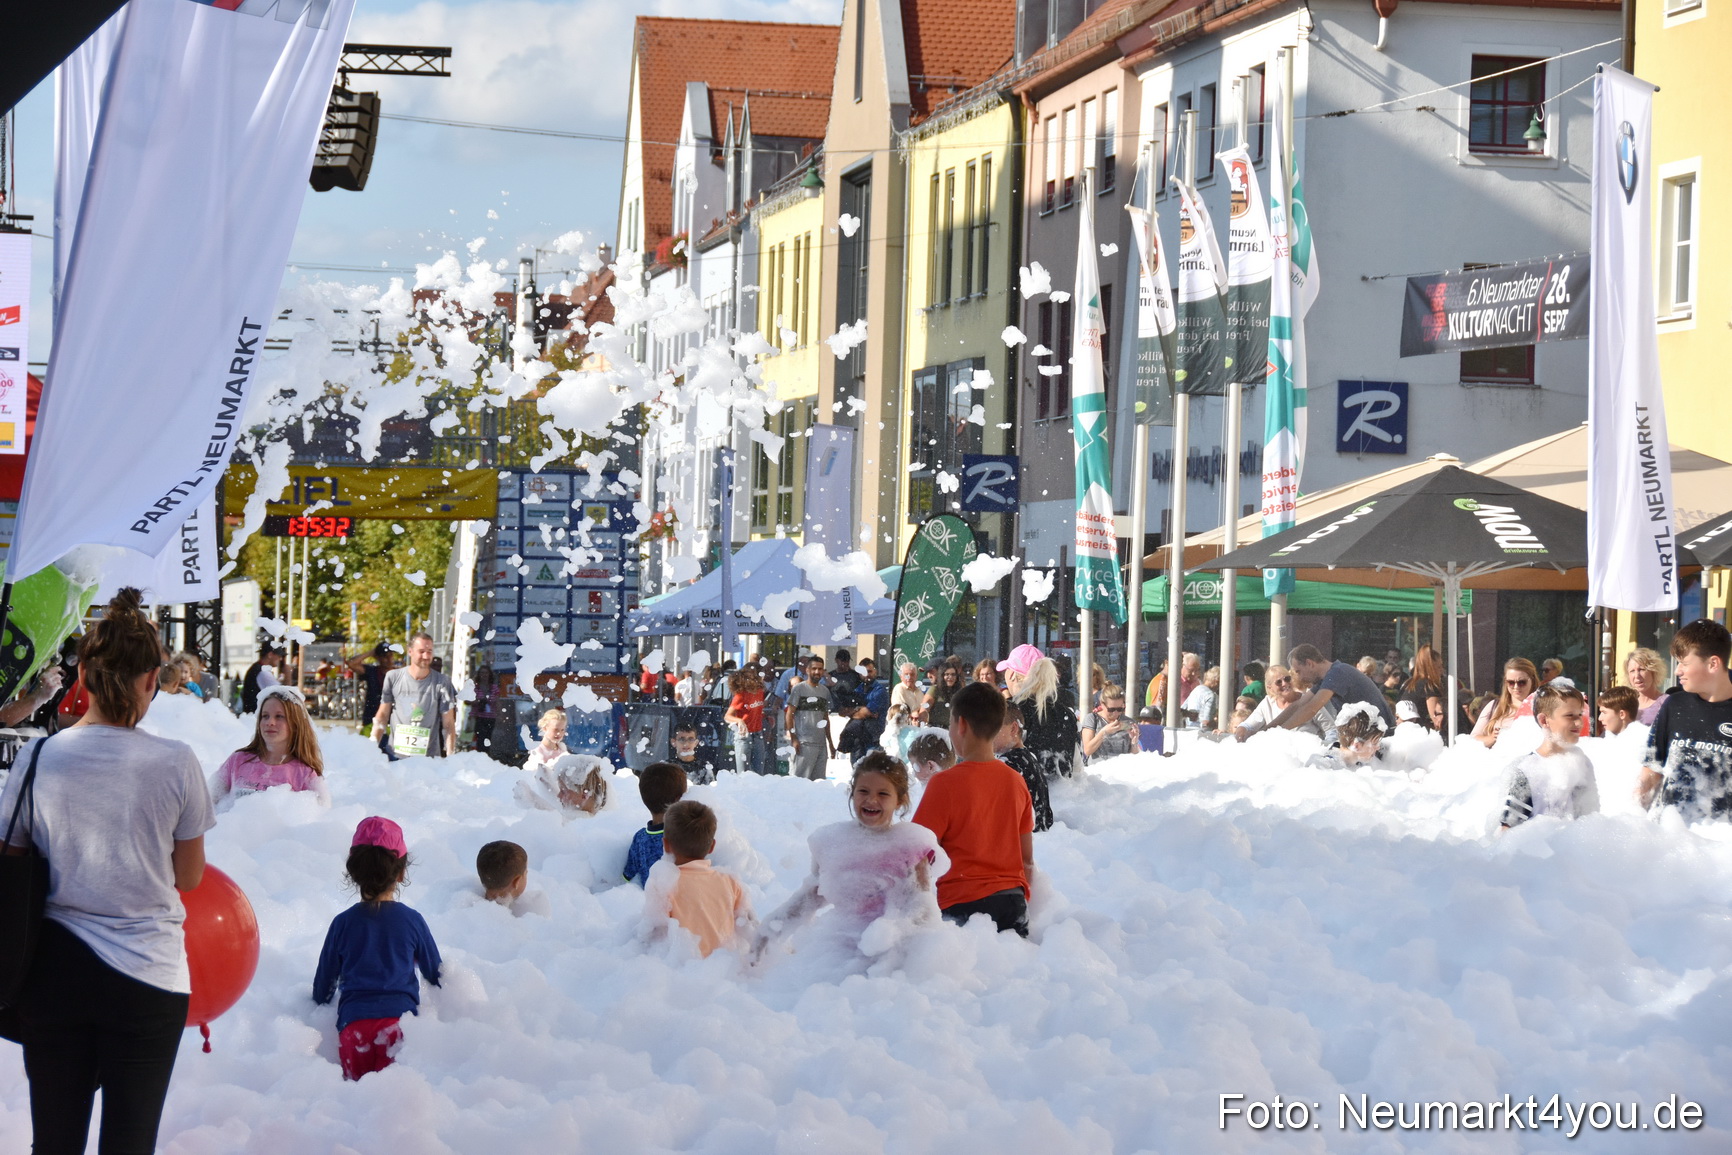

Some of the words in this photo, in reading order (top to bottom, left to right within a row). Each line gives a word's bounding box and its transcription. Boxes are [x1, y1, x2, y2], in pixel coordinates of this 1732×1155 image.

[1545, 264, 1571, 305] 28.
[1447, 303, 1536, 341] KULTURNACHT
[129, 476, 204, 535] PARTL
[196, 316, 262, 473] NEUMARKT
[1634, 400, 1668, 523] NEUMARKT
[1653, 525, 1673, 595] PARTL
[701, 609, 722, 618] BM
[405, 736, 418, 747] 12
